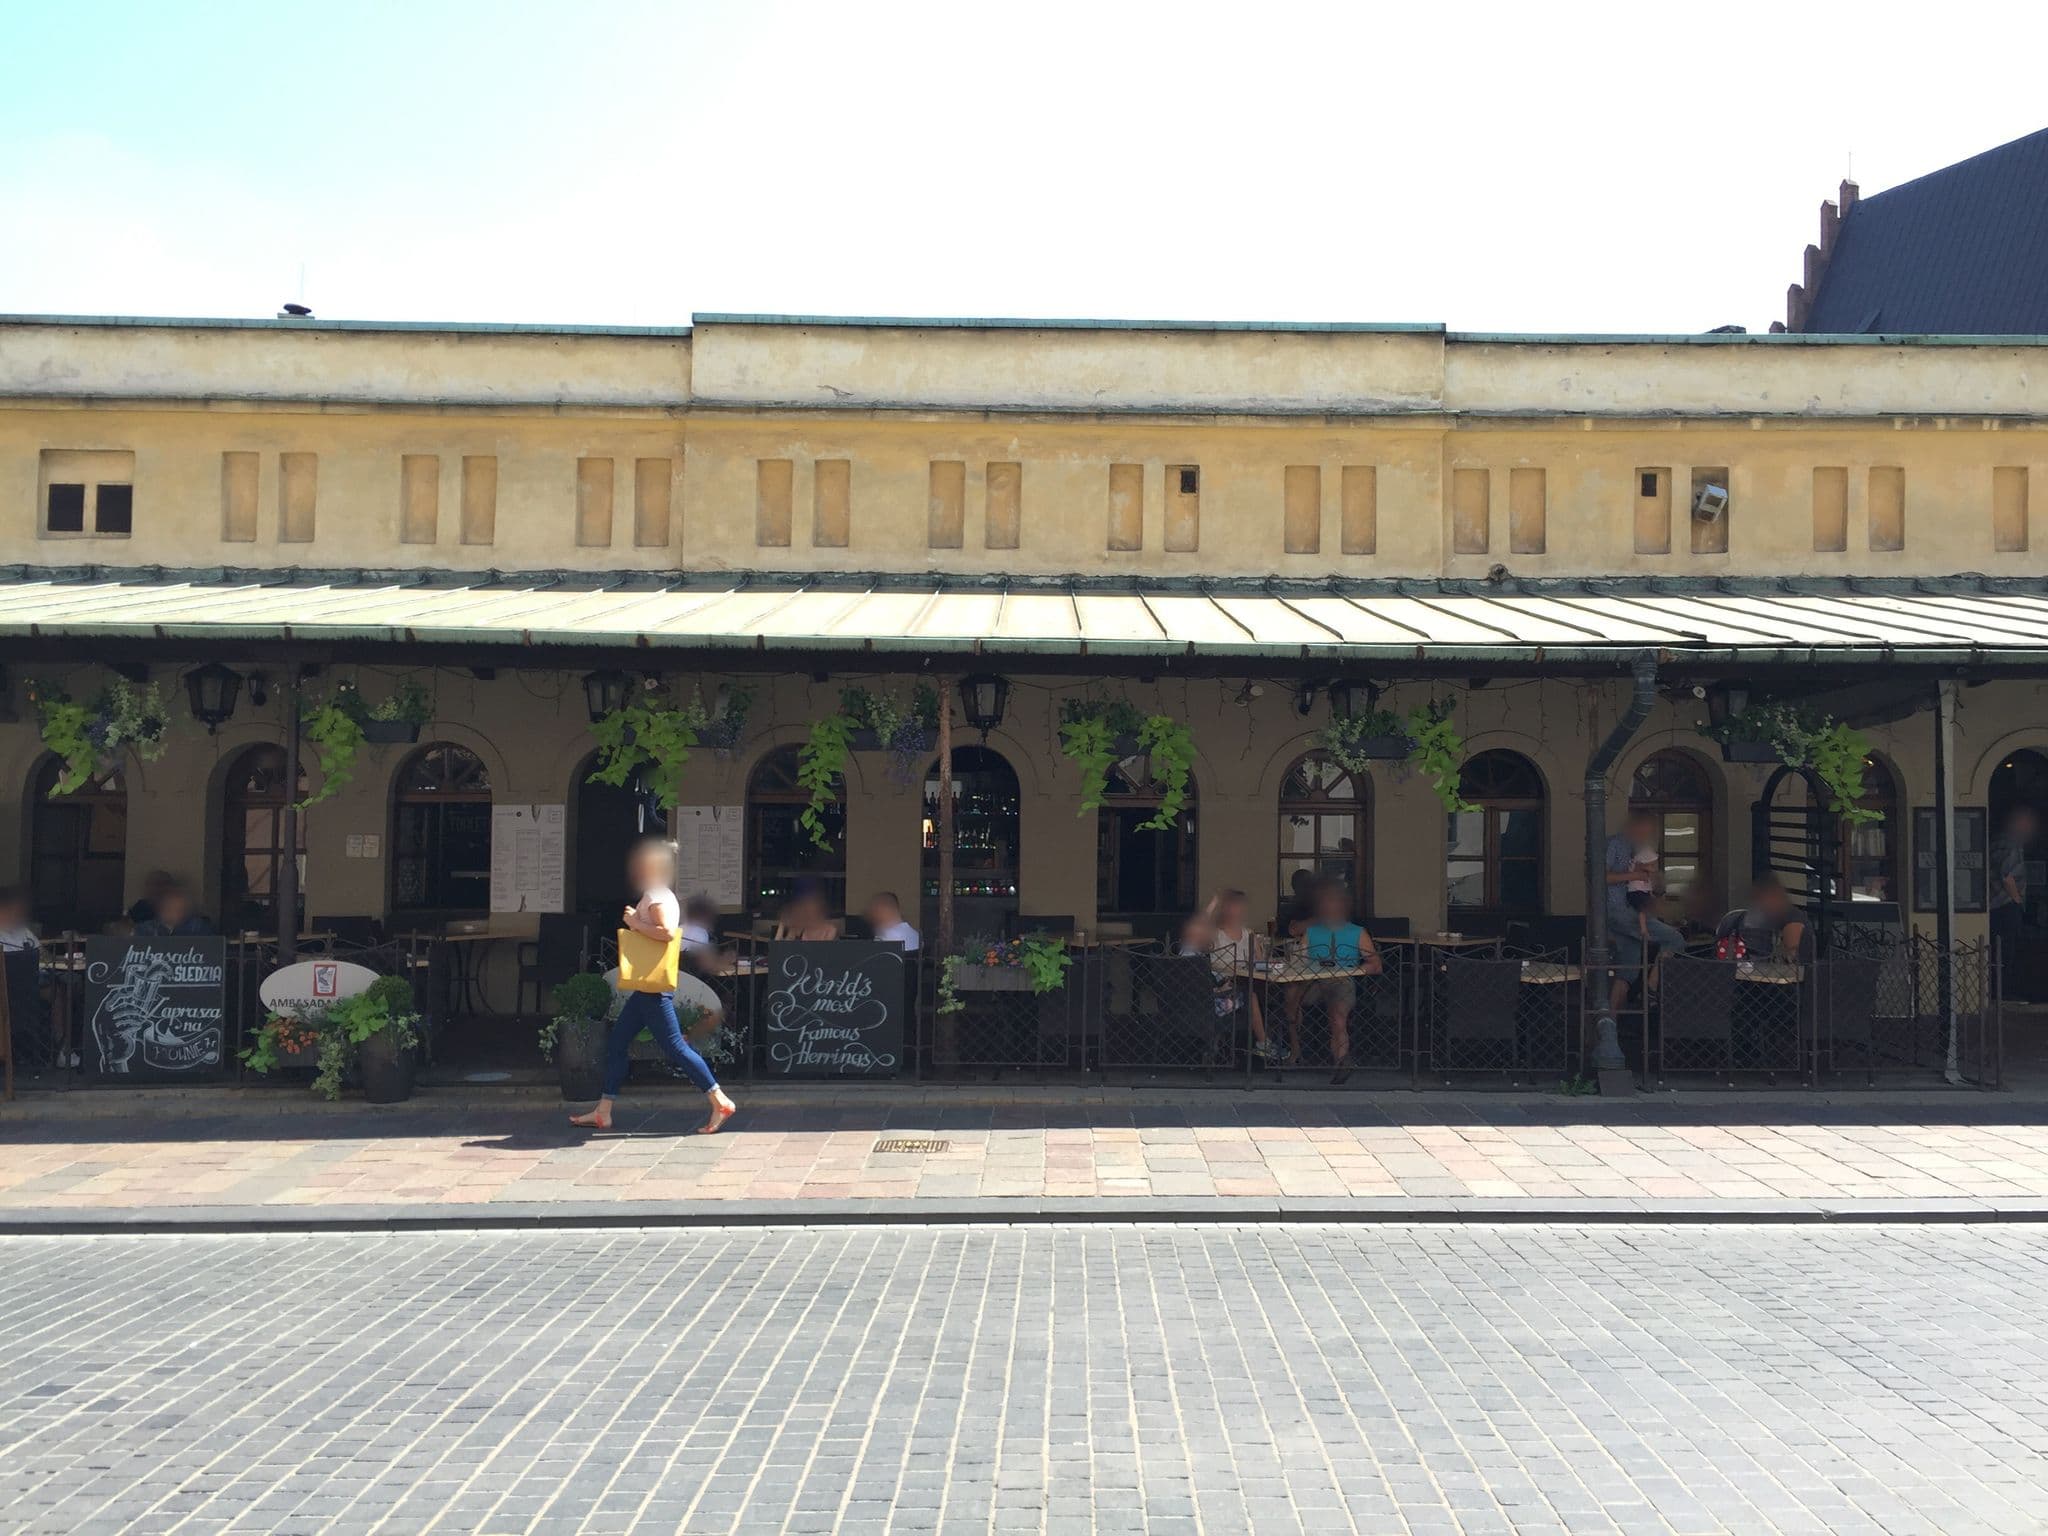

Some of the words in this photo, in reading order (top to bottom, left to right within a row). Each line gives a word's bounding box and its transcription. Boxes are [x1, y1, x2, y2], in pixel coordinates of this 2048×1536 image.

[121, 944, 204, 970] Ambasada
[784, 961, 872, 996] World's
[813, 996, 859, 1013] most
[182, 1021, 202, 1032] na
[796, 1041, 871, 1070] Herrings
